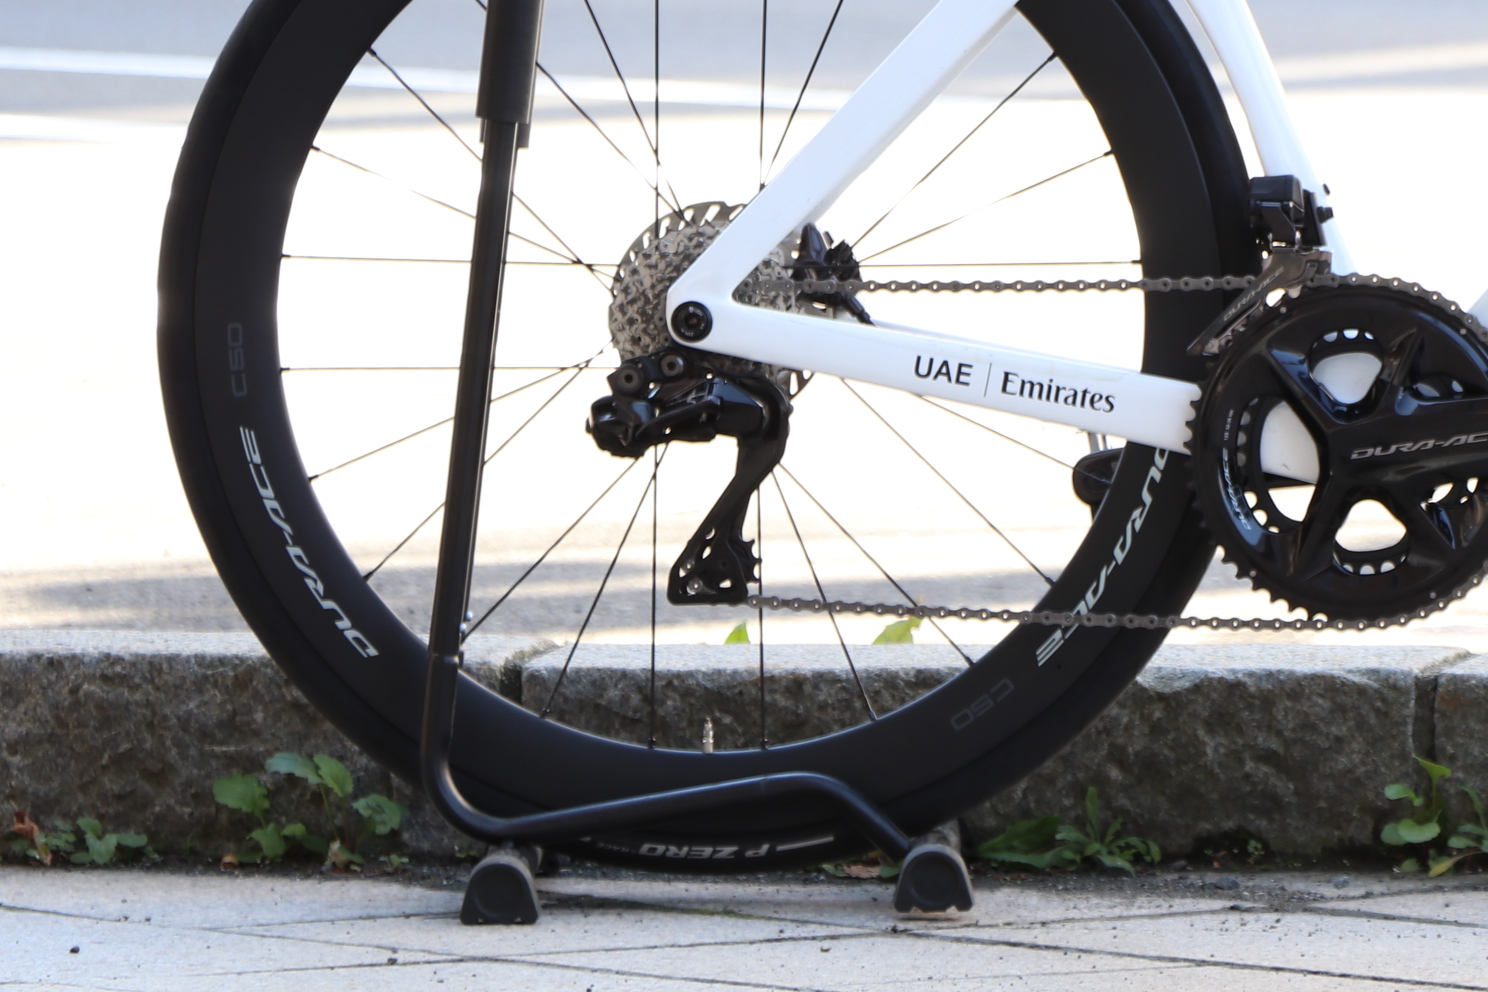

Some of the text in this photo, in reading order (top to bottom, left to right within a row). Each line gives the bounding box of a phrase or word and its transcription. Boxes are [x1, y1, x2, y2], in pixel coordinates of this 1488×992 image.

[914, 355, 1116, 413] UAE Emirates
[227, 322, 379, 658] DURA-ACE C50
[950, 677, 1015, 731] C50
[639, 844, 739, 859] ZERO
[745, 844, 770, 858] P
